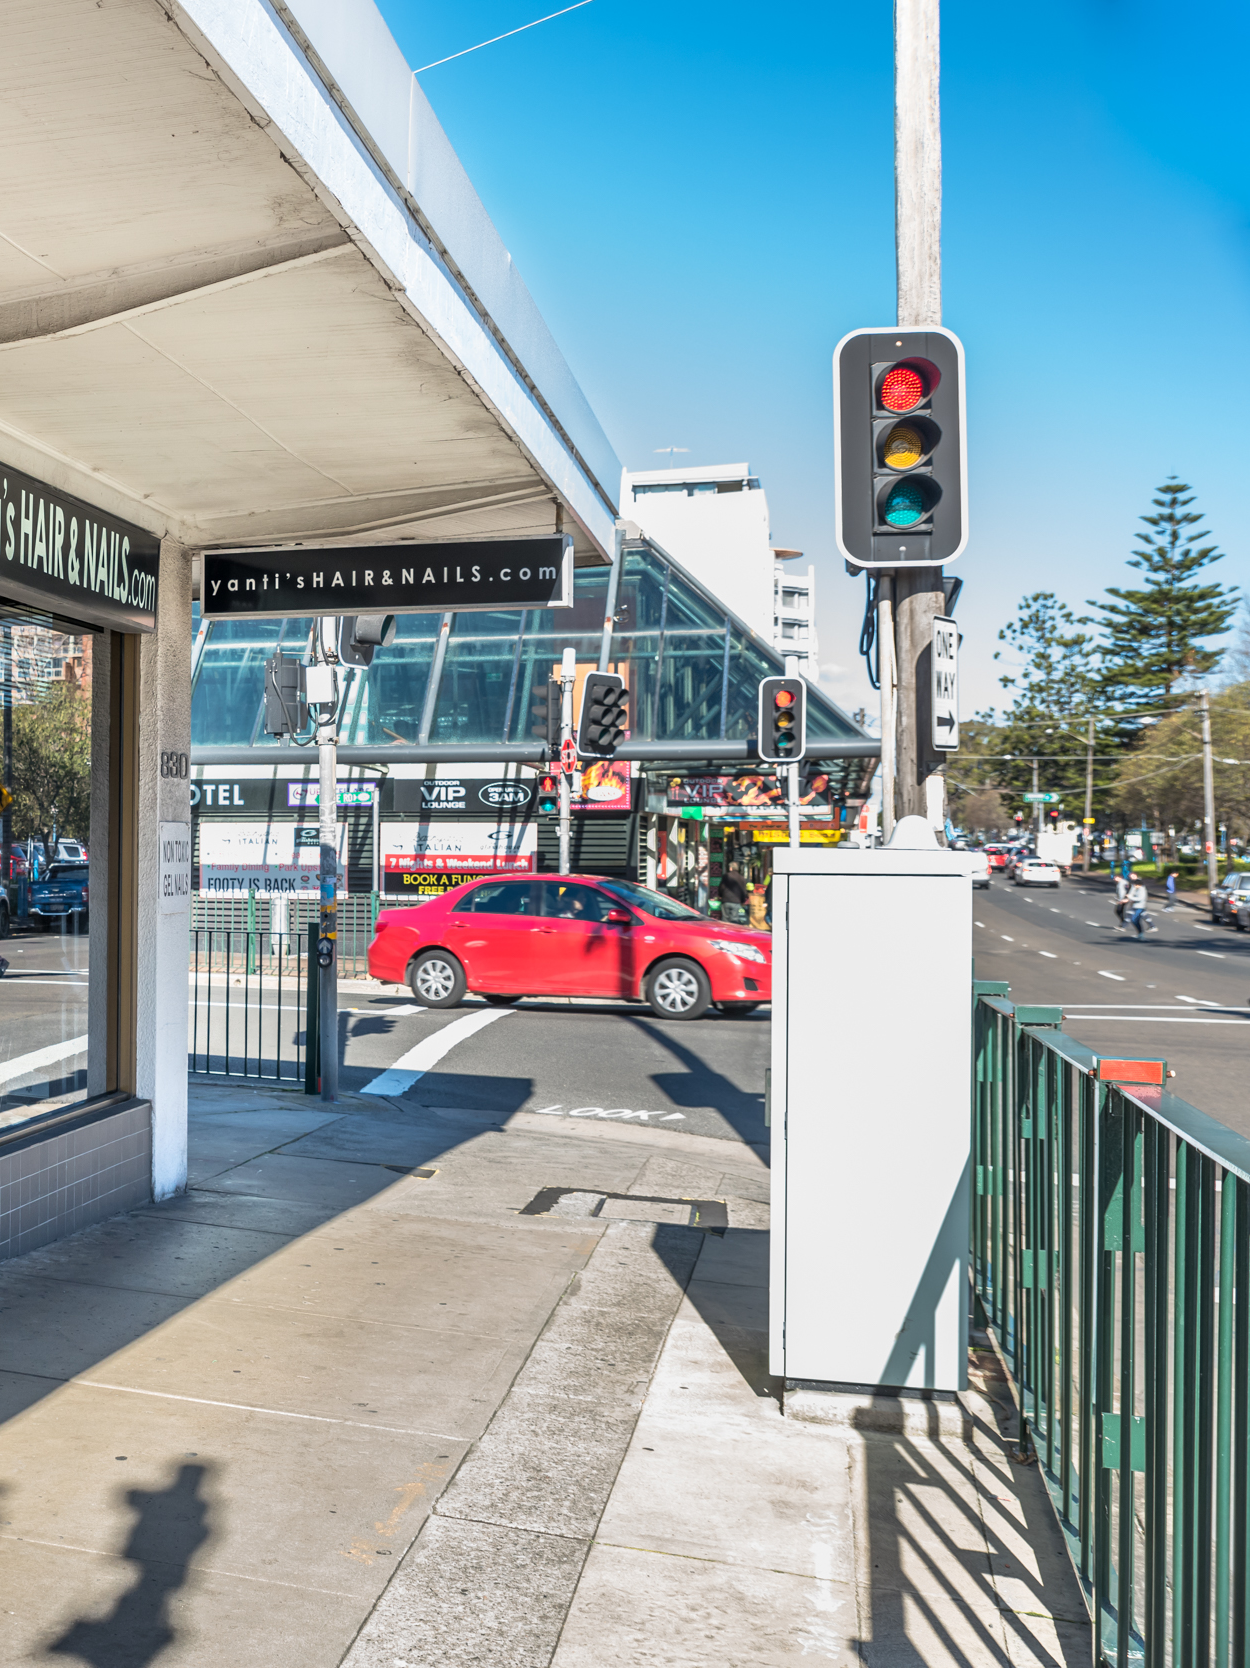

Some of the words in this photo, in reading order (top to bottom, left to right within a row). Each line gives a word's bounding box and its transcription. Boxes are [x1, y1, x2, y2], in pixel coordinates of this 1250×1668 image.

[19, 489, 64, 580] HAIR
[67, 516, 81, 586] &
[83, 519, 156, 612] NAILS.com
[936, 630, 954, 660] ONE
[936, 671, 956, 700] WAY
[161, 751, 188, 779] 830
[420, 786, 467, 801] VIP
[488, 792, 525, 802] 3AM
[684, 784, 724, 798] VIP
[421, 801, 466, 809] LOUNGE
[413, 843, 462, 851] ITALIAN
[211, 863, 241, 873] Family
[241, 863, 270, 873] Dining
[278, 863, 299, 871] Park
[390, 858, 397, 869] 7
[398, 857, 433, 871] Nights
[435, 858, 444, 869] &
[446, 858, 494, 870] Weekend
[496, 858, 529, 870] Lunch
[207, 877, 244, 892] FOOTY
[248, 877, 260, 893] IS
[264, 877, 296, 893] BACK
[403, 874, 438, 885] BOOK
[439, 874, 449, 885] A
[418, 886, 445, 895] FREE
[535, 1104, 667, 1121] LOOK
